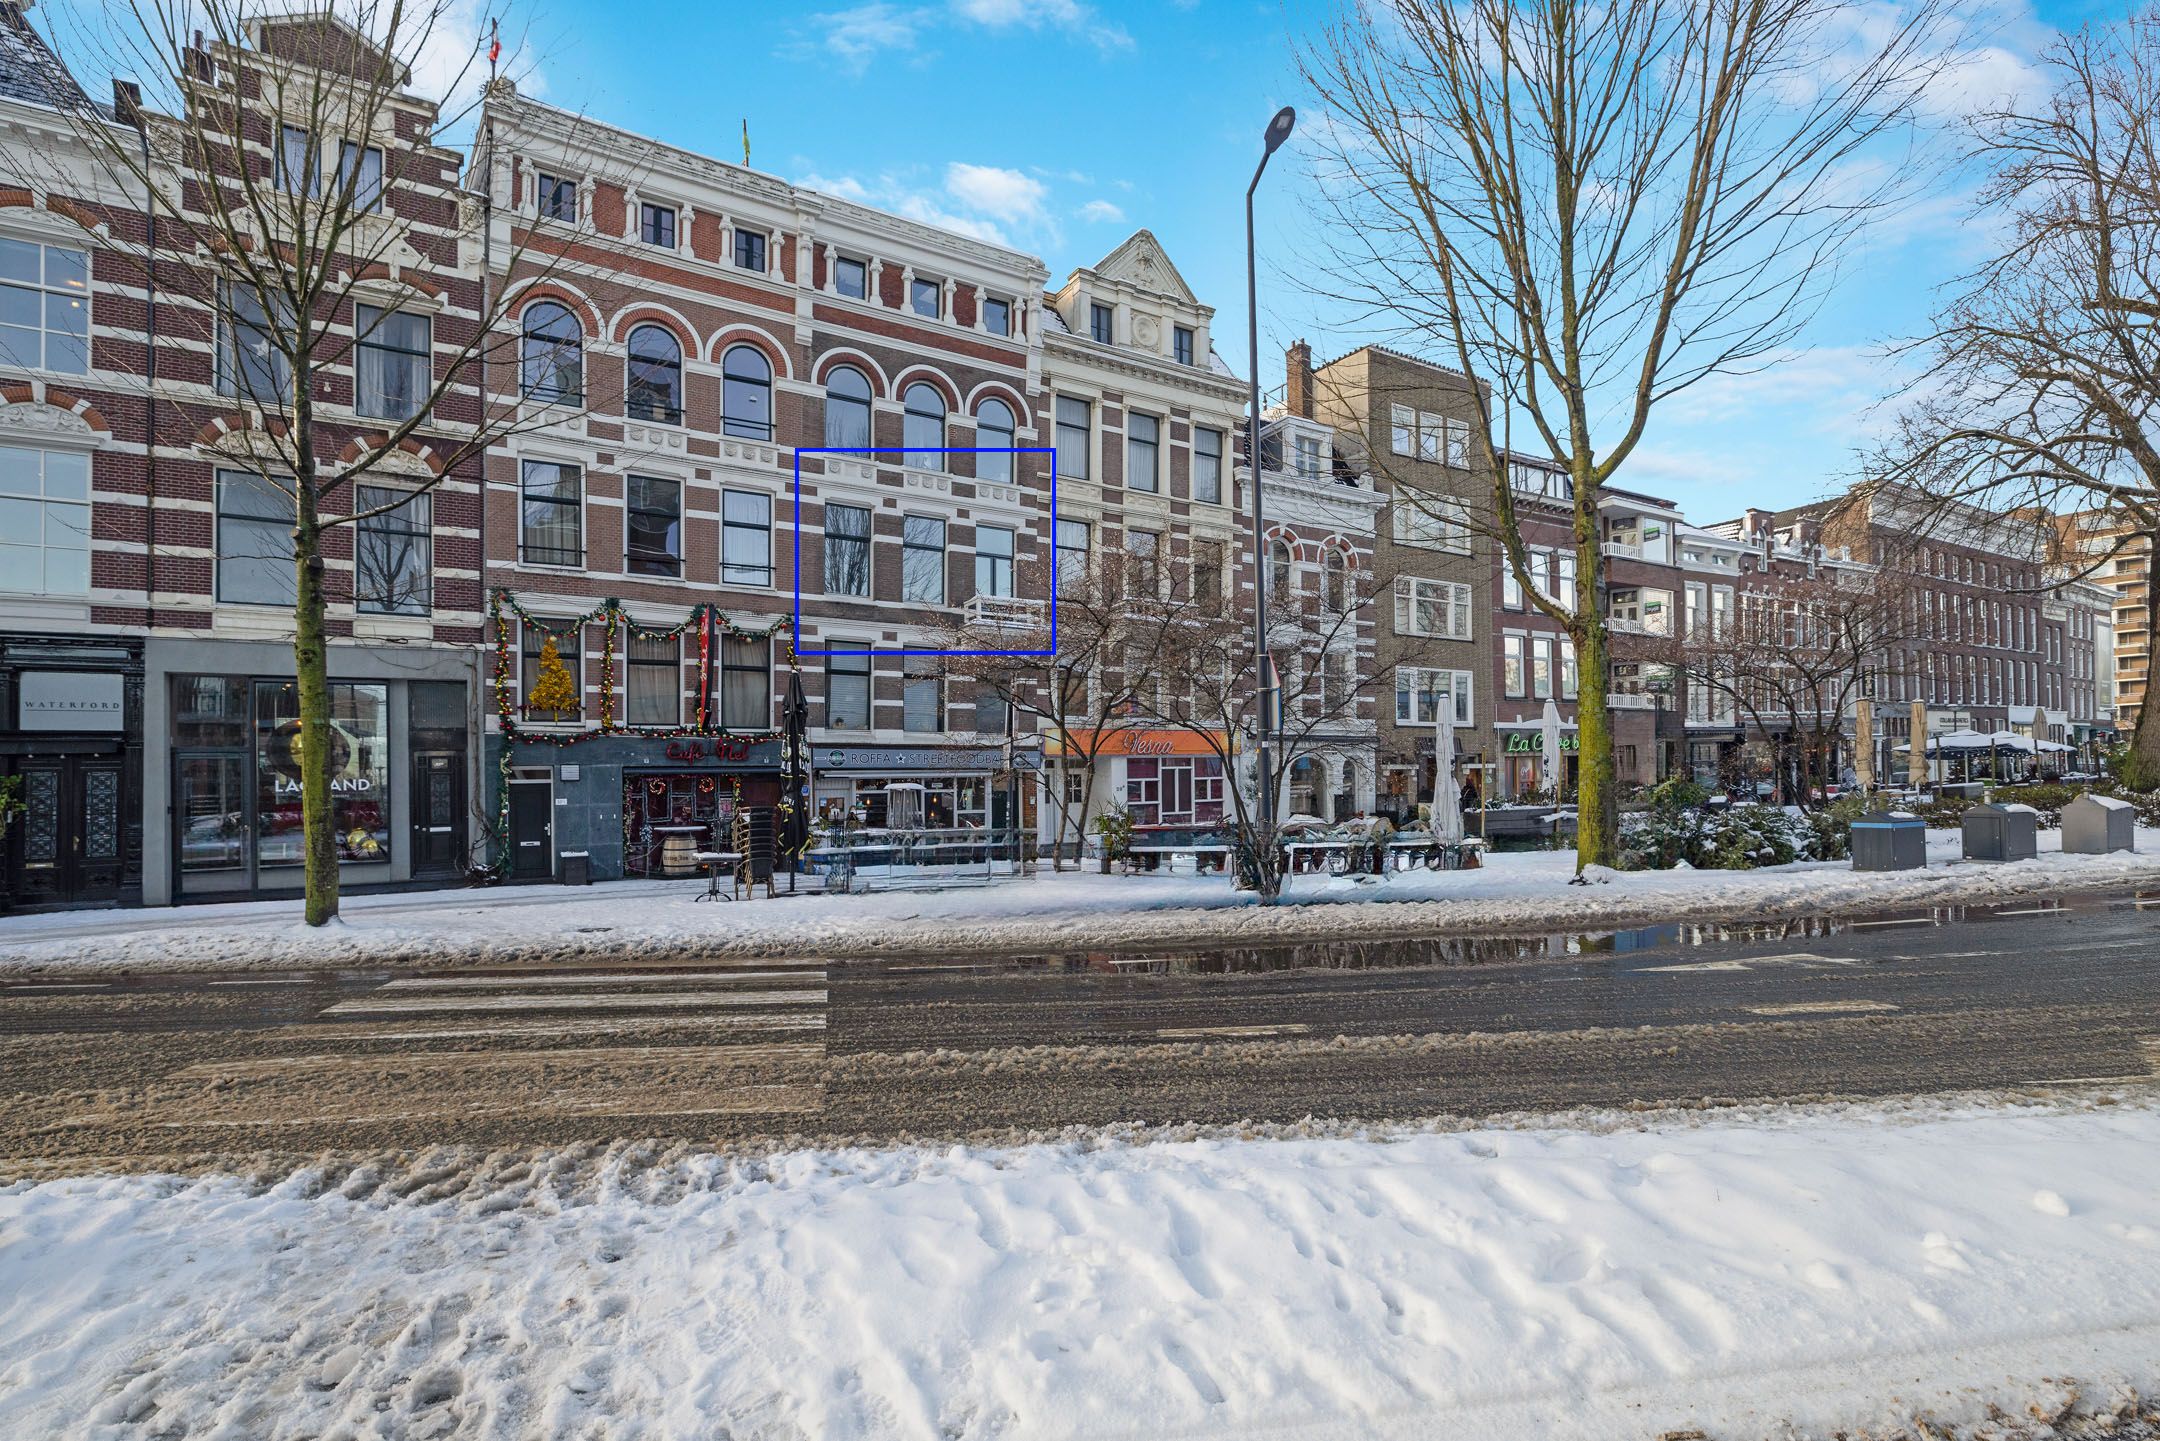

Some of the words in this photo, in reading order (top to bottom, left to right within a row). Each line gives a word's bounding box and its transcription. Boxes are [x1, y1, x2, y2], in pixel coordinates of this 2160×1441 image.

[1123, 731, 1175, 754] Vesna
[1508, 733, 1530, 751] La
[851, 753, 891, 763] ROFFA
